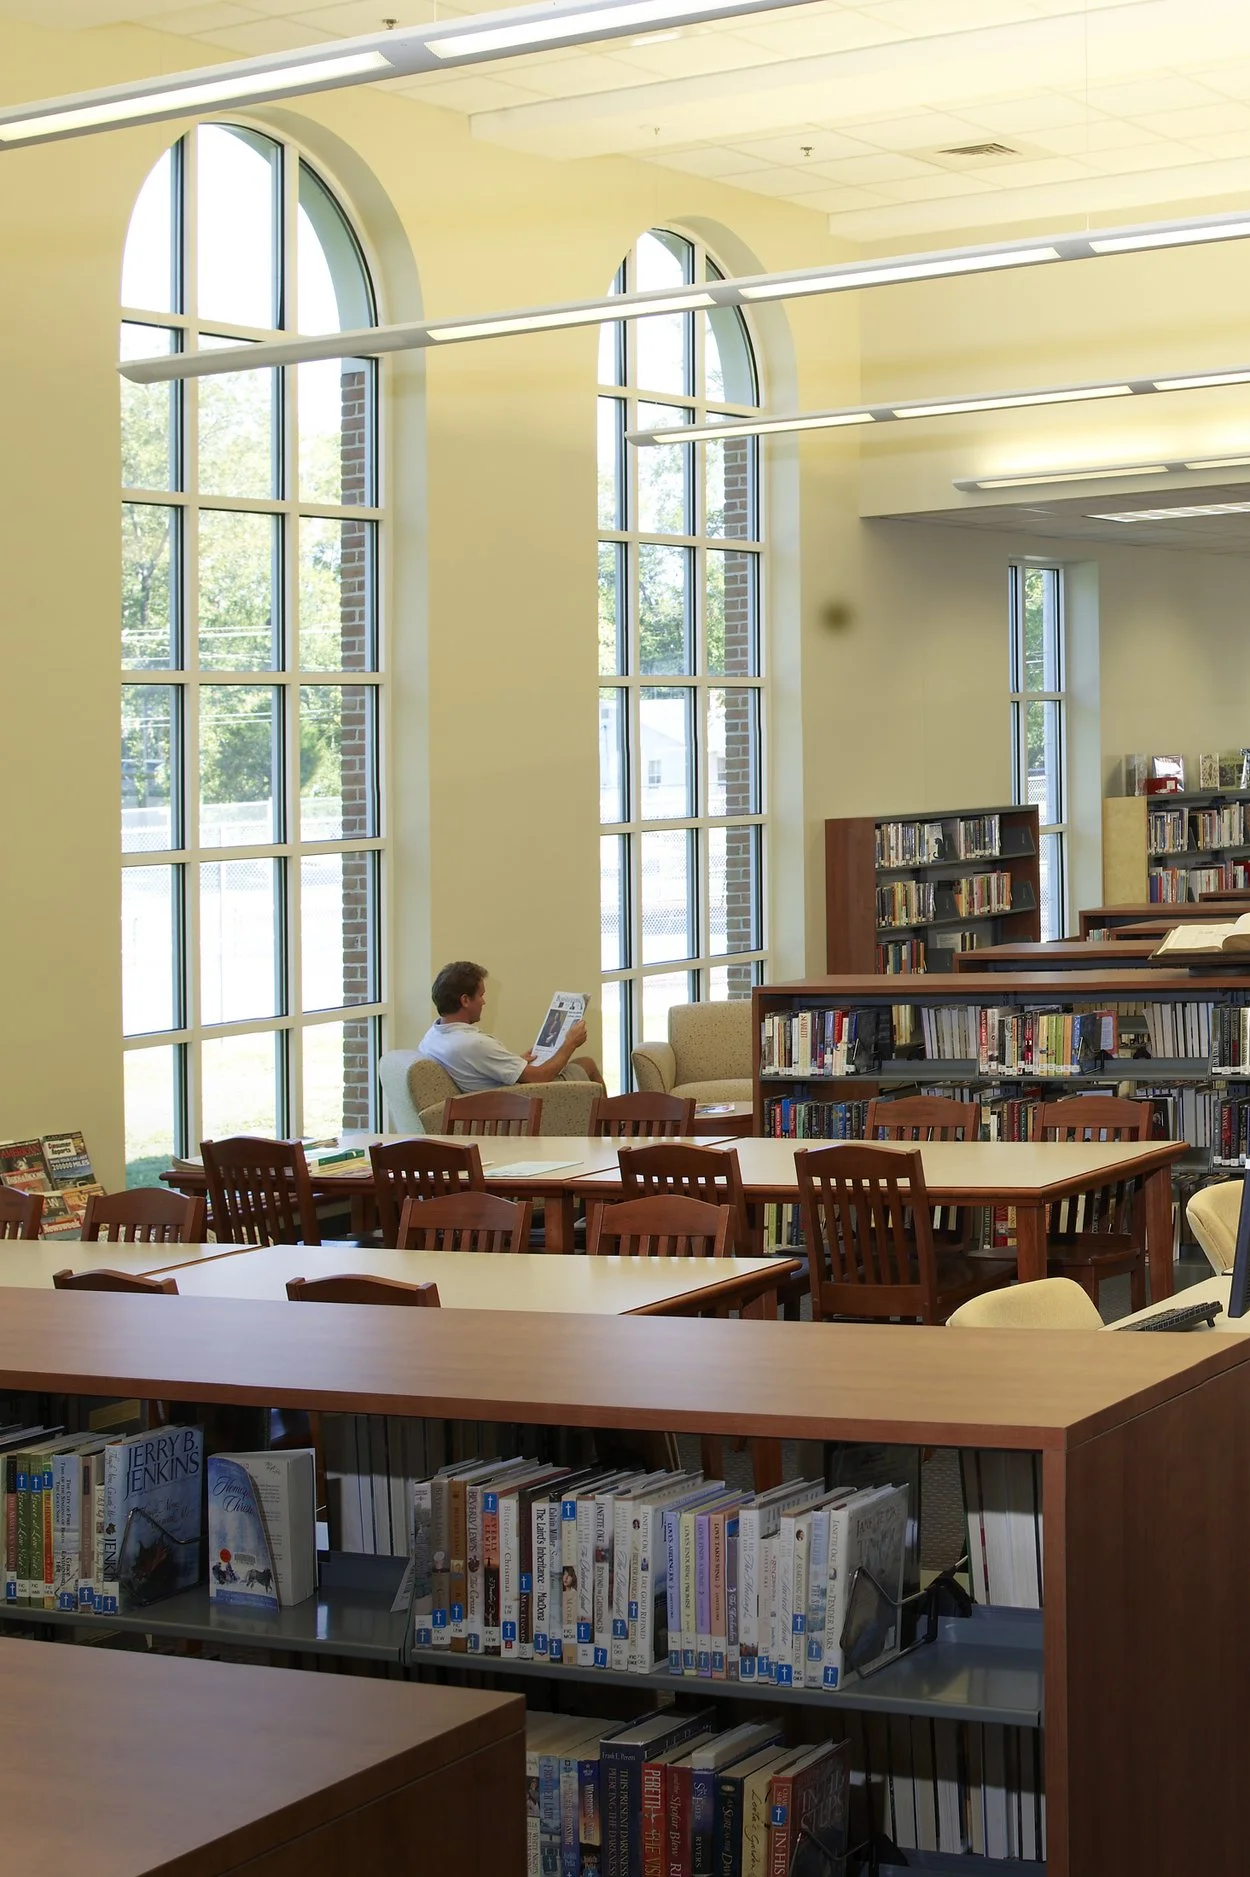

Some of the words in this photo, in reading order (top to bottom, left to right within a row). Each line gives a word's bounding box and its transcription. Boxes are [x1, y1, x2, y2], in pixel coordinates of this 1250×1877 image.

[42, 1120, 81, 1134] Newsweek
[48, 1142, 72, 1150] Consumer
[51, 1147, 72, 1156] Reports
[72, 1159, 91, 1168] MILES
[126, 1434, 182, 1473] JERRY
[184, 1430, 200, 1457] B.
[124, 1452, 201, 1502] JENKINS
[30, 1494, 42, 1518] Grace
[65, 1504, 72, 1513] OF
[468, 1491, 478, 1526] BEVERLY
[536, 1508, 547, 1522] The
[549, 1507, 557, 1528] Calvin
[595, 1502, 605, 1528] JANETTE
[536, 1522, 547, 1545] Laird's
[595, 1529, 605, 1543] OKE
[640, 1512, 649, 1538] JANETTE
[697, 1524, 705, 1541] LOVE
[830, 1520, 841, 1547] JANETTE
[468, 1526, 478, 1552] LEWIS
[549, 1528, 557, 1548] Miller
[640, 1539, 649, 1553] OKE
[683, 1547, 691, 1581] ENDURING
[697, 1542, 705, 1562] FINDS
[830, 1548, 841, 1563] OKE
[503, 1552, 512, 1593] Christmas
[536, 1546, 547, 1584] Inheritance
[640, 1576, 649, 1590] LIKE
[794, 1562, 803, 1593] SEARCHING
[520, 1594, 528, 1612] MAX
[640, 1590, 649, 1610] GOLD
[683, 1582, 691, 1610] PROMISE
[794, 1594, 803, 1613] HEART
[826, 1594, 837, 1626] TENDER
[640, 1611, 649, 1640] REFINED
[826, 1626, 836, 1650] YEARS
[794, 1652, 803, 1664] OKE
[601, 1751, 615, 1762] Frank
[620, 1752, 637, 1762] Peretti
[543, 1764, 554, 1800] FRONTIER
[607, 1768, 618, 1810] PIERCING
[618, 1768, 630, 1790] THIS
[644, 1769, 662, 1809] PERETTI
[543, 1802, 554, 1820] LADY
[607, 1812, 618, 1830] THE
[618, 1789, 630, 1830] PRESENT
[670, 1794, 682, 1830] Shofar
[721, 1807, 735, 1832] SURE
[750, 1789, 764, 1831] Leota's
[644, 1830, 661, 1855] THE
[670, 1831, 682, 1857] Blew
[744, 1833, 761, 1870] Garden
[774, 1831, 787, 1848] IN
[607, 1830, 618, 1877] DARKNESS
[618, 1830, 630, 1877] DARKNESS
[695, 1836, 703, 1869] RIVERS
[774, 1852, 787, 1876] HIS
